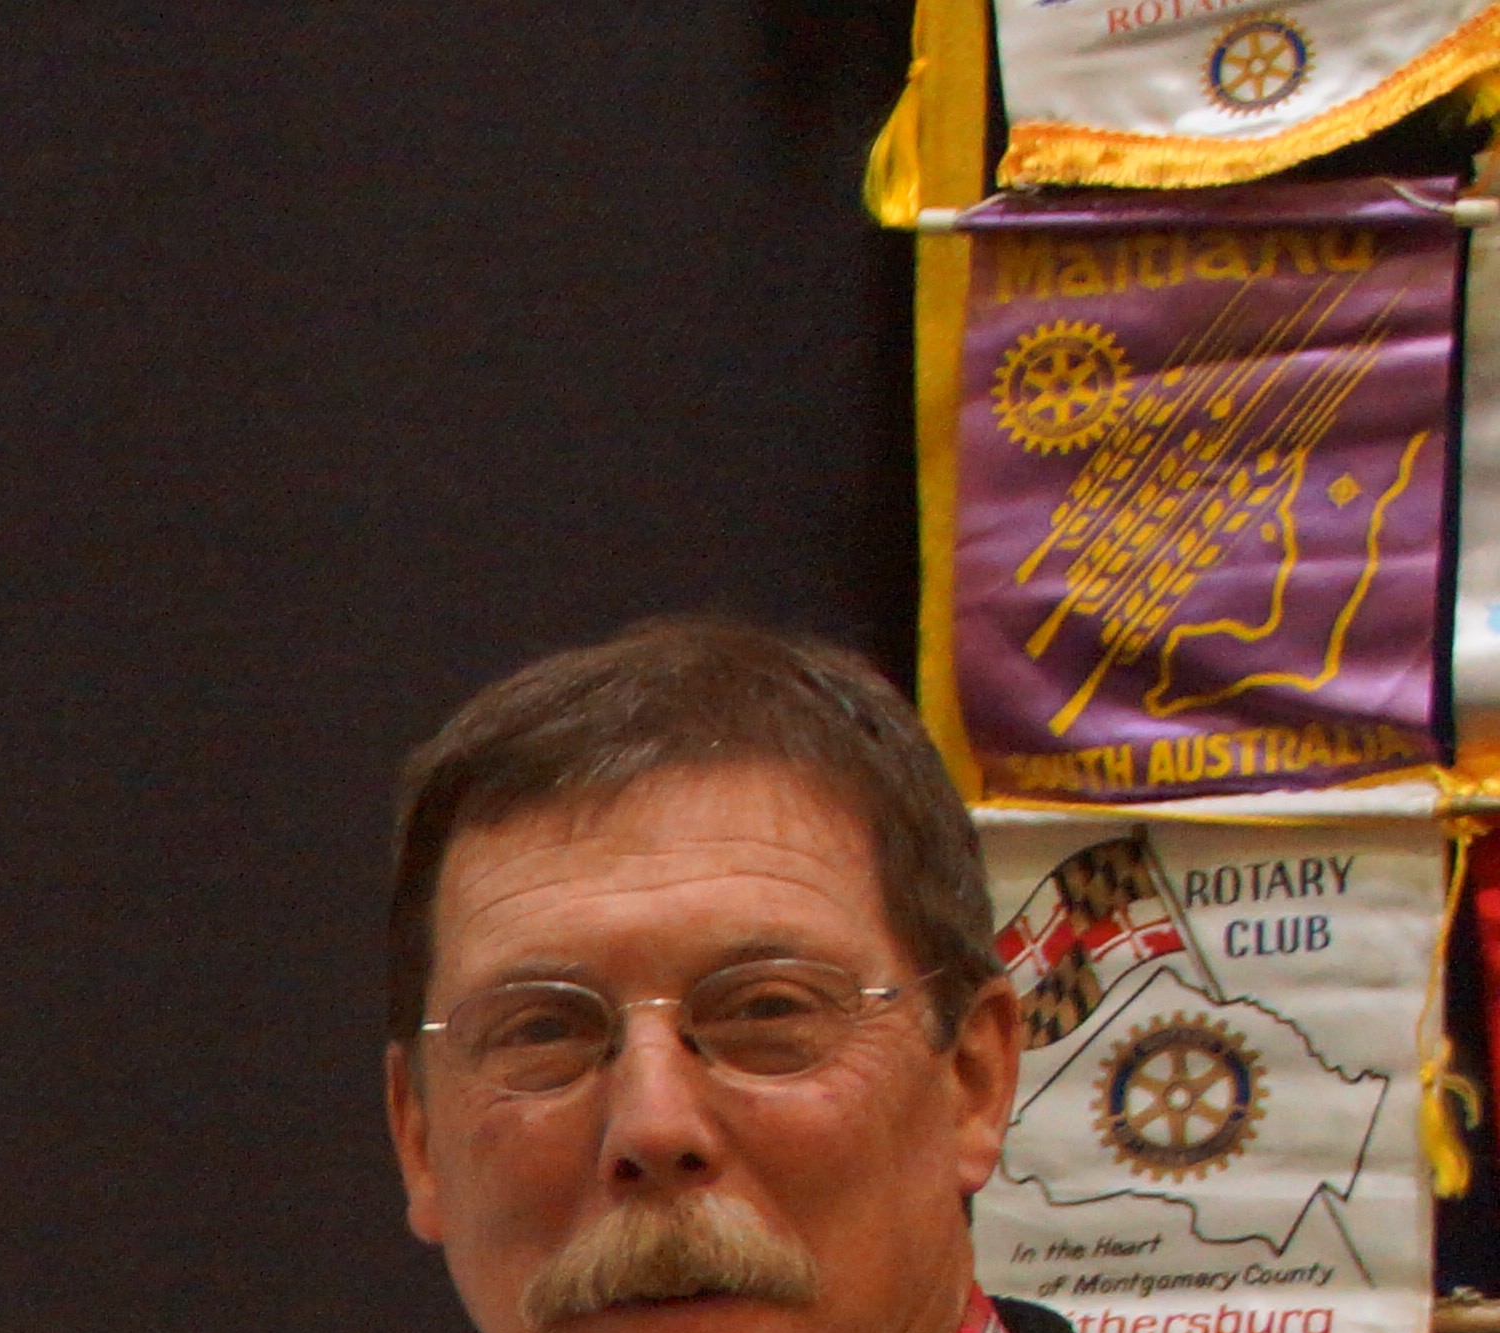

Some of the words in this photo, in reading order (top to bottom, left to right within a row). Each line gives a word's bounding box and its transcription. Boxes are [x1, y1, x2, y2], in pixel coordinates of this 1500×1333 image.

[1105, 0, 1240, 34] ROT
[1147, 721, 1410, 785] AUSTRALIA
[1184, 856, 1355, 907] ROTARY
[1223, 915, 1332, 958] CLUB
[1010, 1243, 1037, 1264] In
[1043, 1234, 1085, 1261] the
[1090, 1232, 1163, 1258] Heart
[1038, 1273, 1069, 1299] of
[1072, 1262, 1240, 1297] Montgomery
[1242, 1261, 1336, 1287] County
